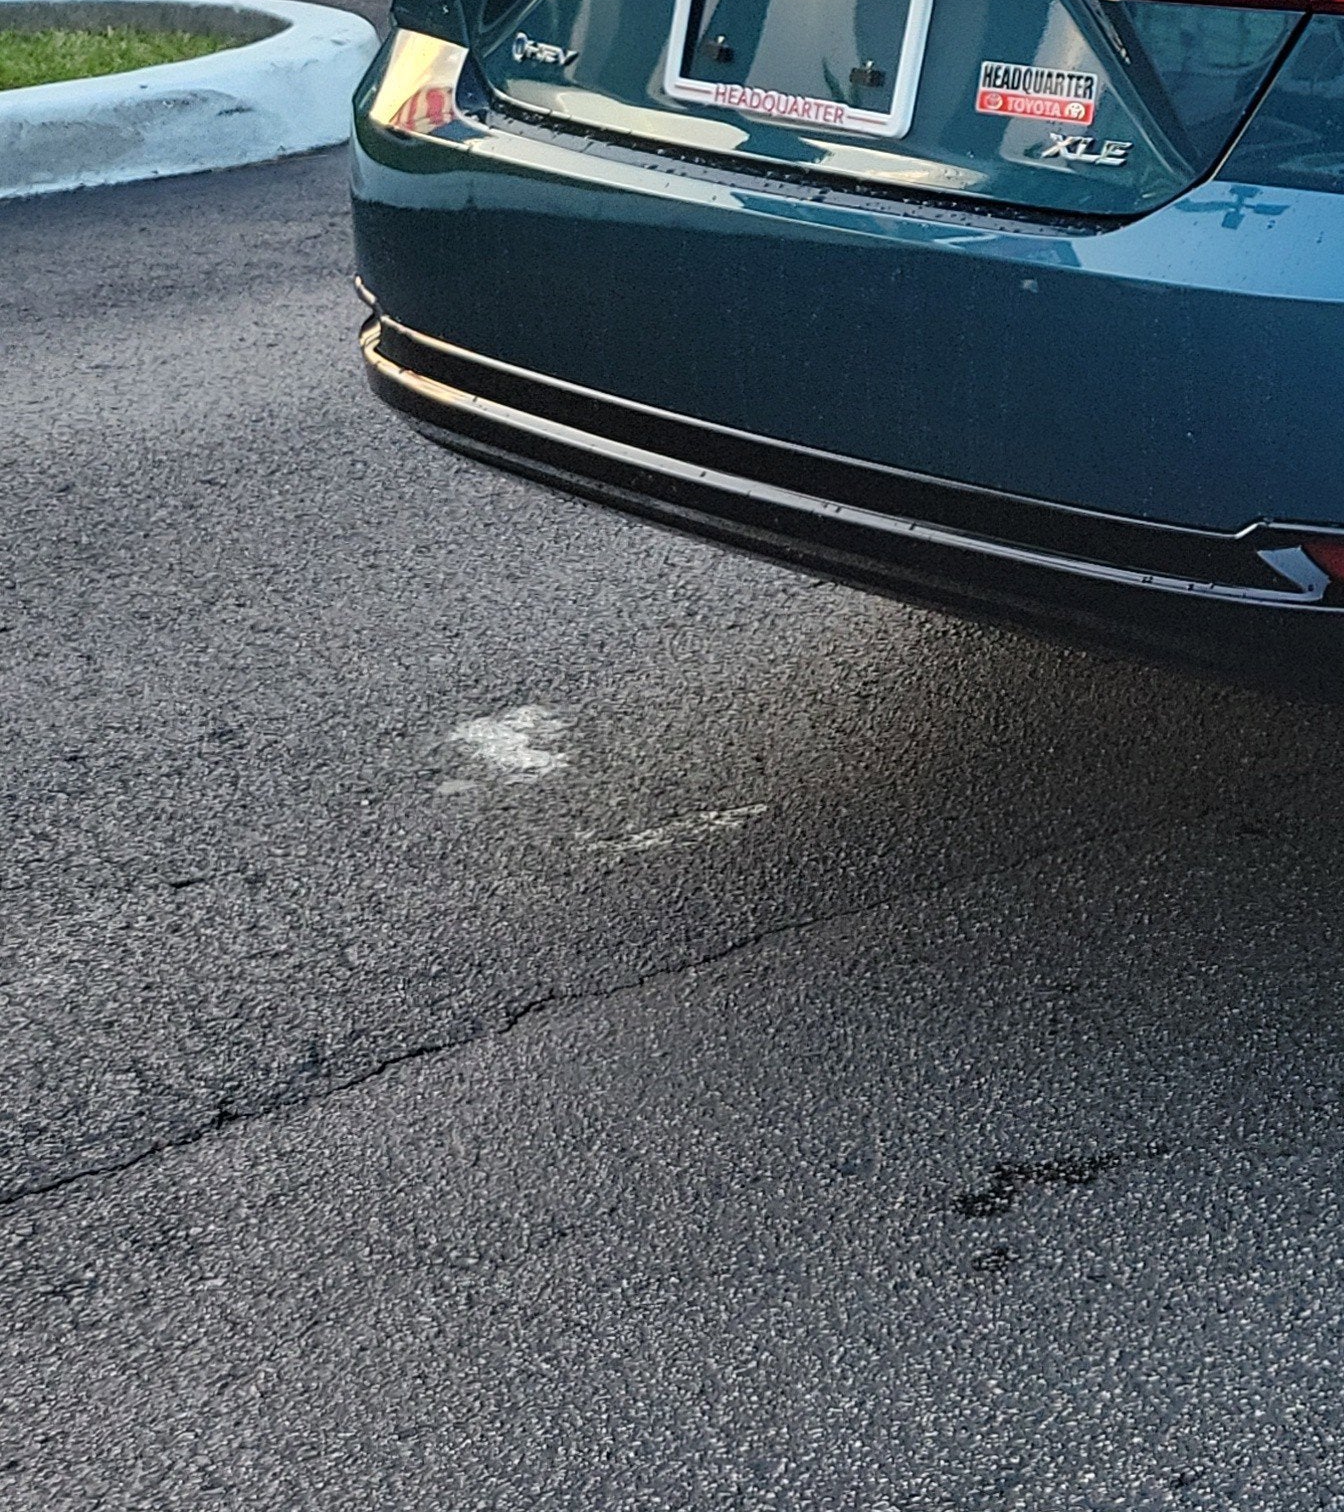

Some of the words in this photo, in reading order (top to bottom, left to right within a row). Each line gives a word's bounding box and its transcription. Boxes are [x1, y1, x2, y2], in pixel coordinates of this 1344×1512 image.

[982, 63, 1095, 101] HEADQUARTER
[713, 82, 847, 125] HEADQUARTER
[1006, 96, 1063, 118] TOYOTA
[1040, 132, 1134, 167] XLE
